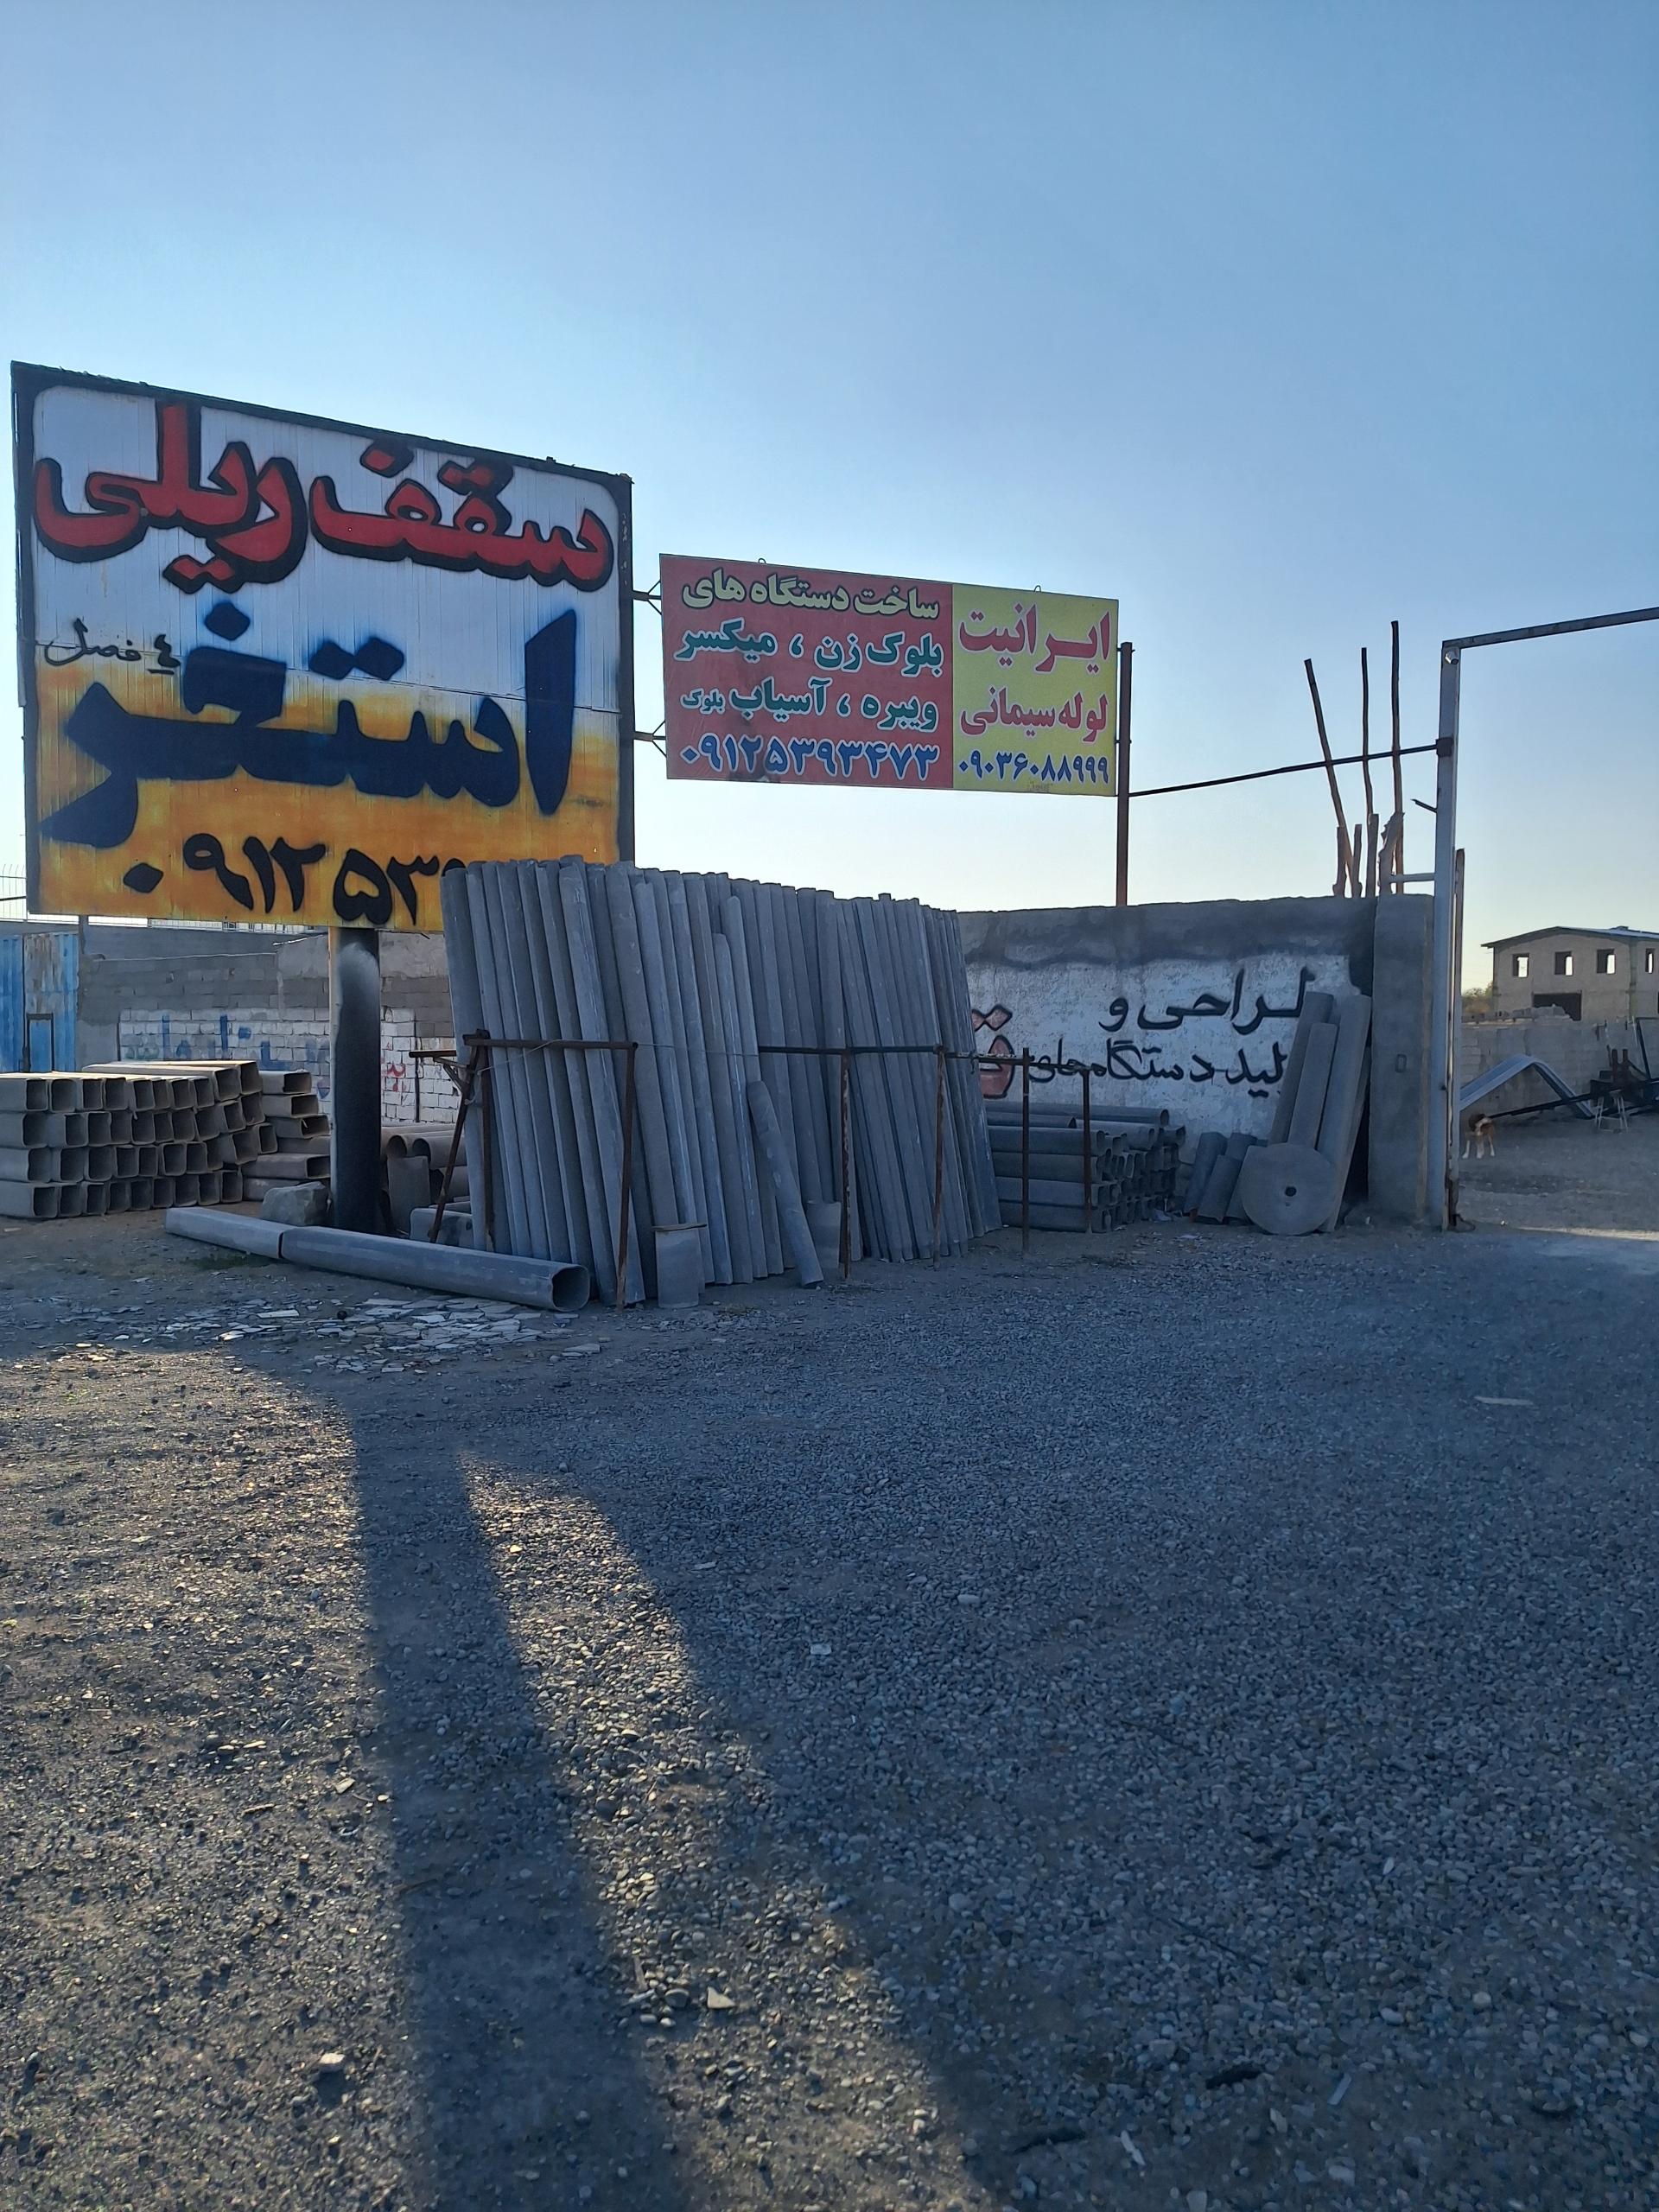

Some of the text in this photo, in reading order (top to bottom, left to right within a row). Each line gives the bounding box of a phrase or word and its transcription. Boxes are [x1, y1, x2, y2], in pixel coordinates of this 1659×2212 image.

[33, 399, 614, 594] سقف ریلی
[681, 567, 940, 619] ساخت دستگاه های
[44, 617, 143, 667] فصل
[673, 616, 778, 664] میکسر
[814, 632, 862, 672] زن
[864, 630, 944, 678] بلوک
[958, 603, 1110, 673] ایرانیت
[680, 688, 726, 715] بلوک
[728, 677, 832, 722] آسیاب
[861, 694, 940, 732] ویبره
[960, 685, 1109, 743] لوله سیمانی
[39, 601, 578, 849] استخر
[679, 733, 941, 780] ۰۹۱۲۵۳۹۳۴۷۳
[958, 749, 1109, 785] ۰۹۰۳۶۰۸۸۹۹۹
[123, 832, 466, 926] ۰۹۱۲۵۳
[1098, 997, 1128, 1033] و
[1224, 1041, 1288, 1098] لید
